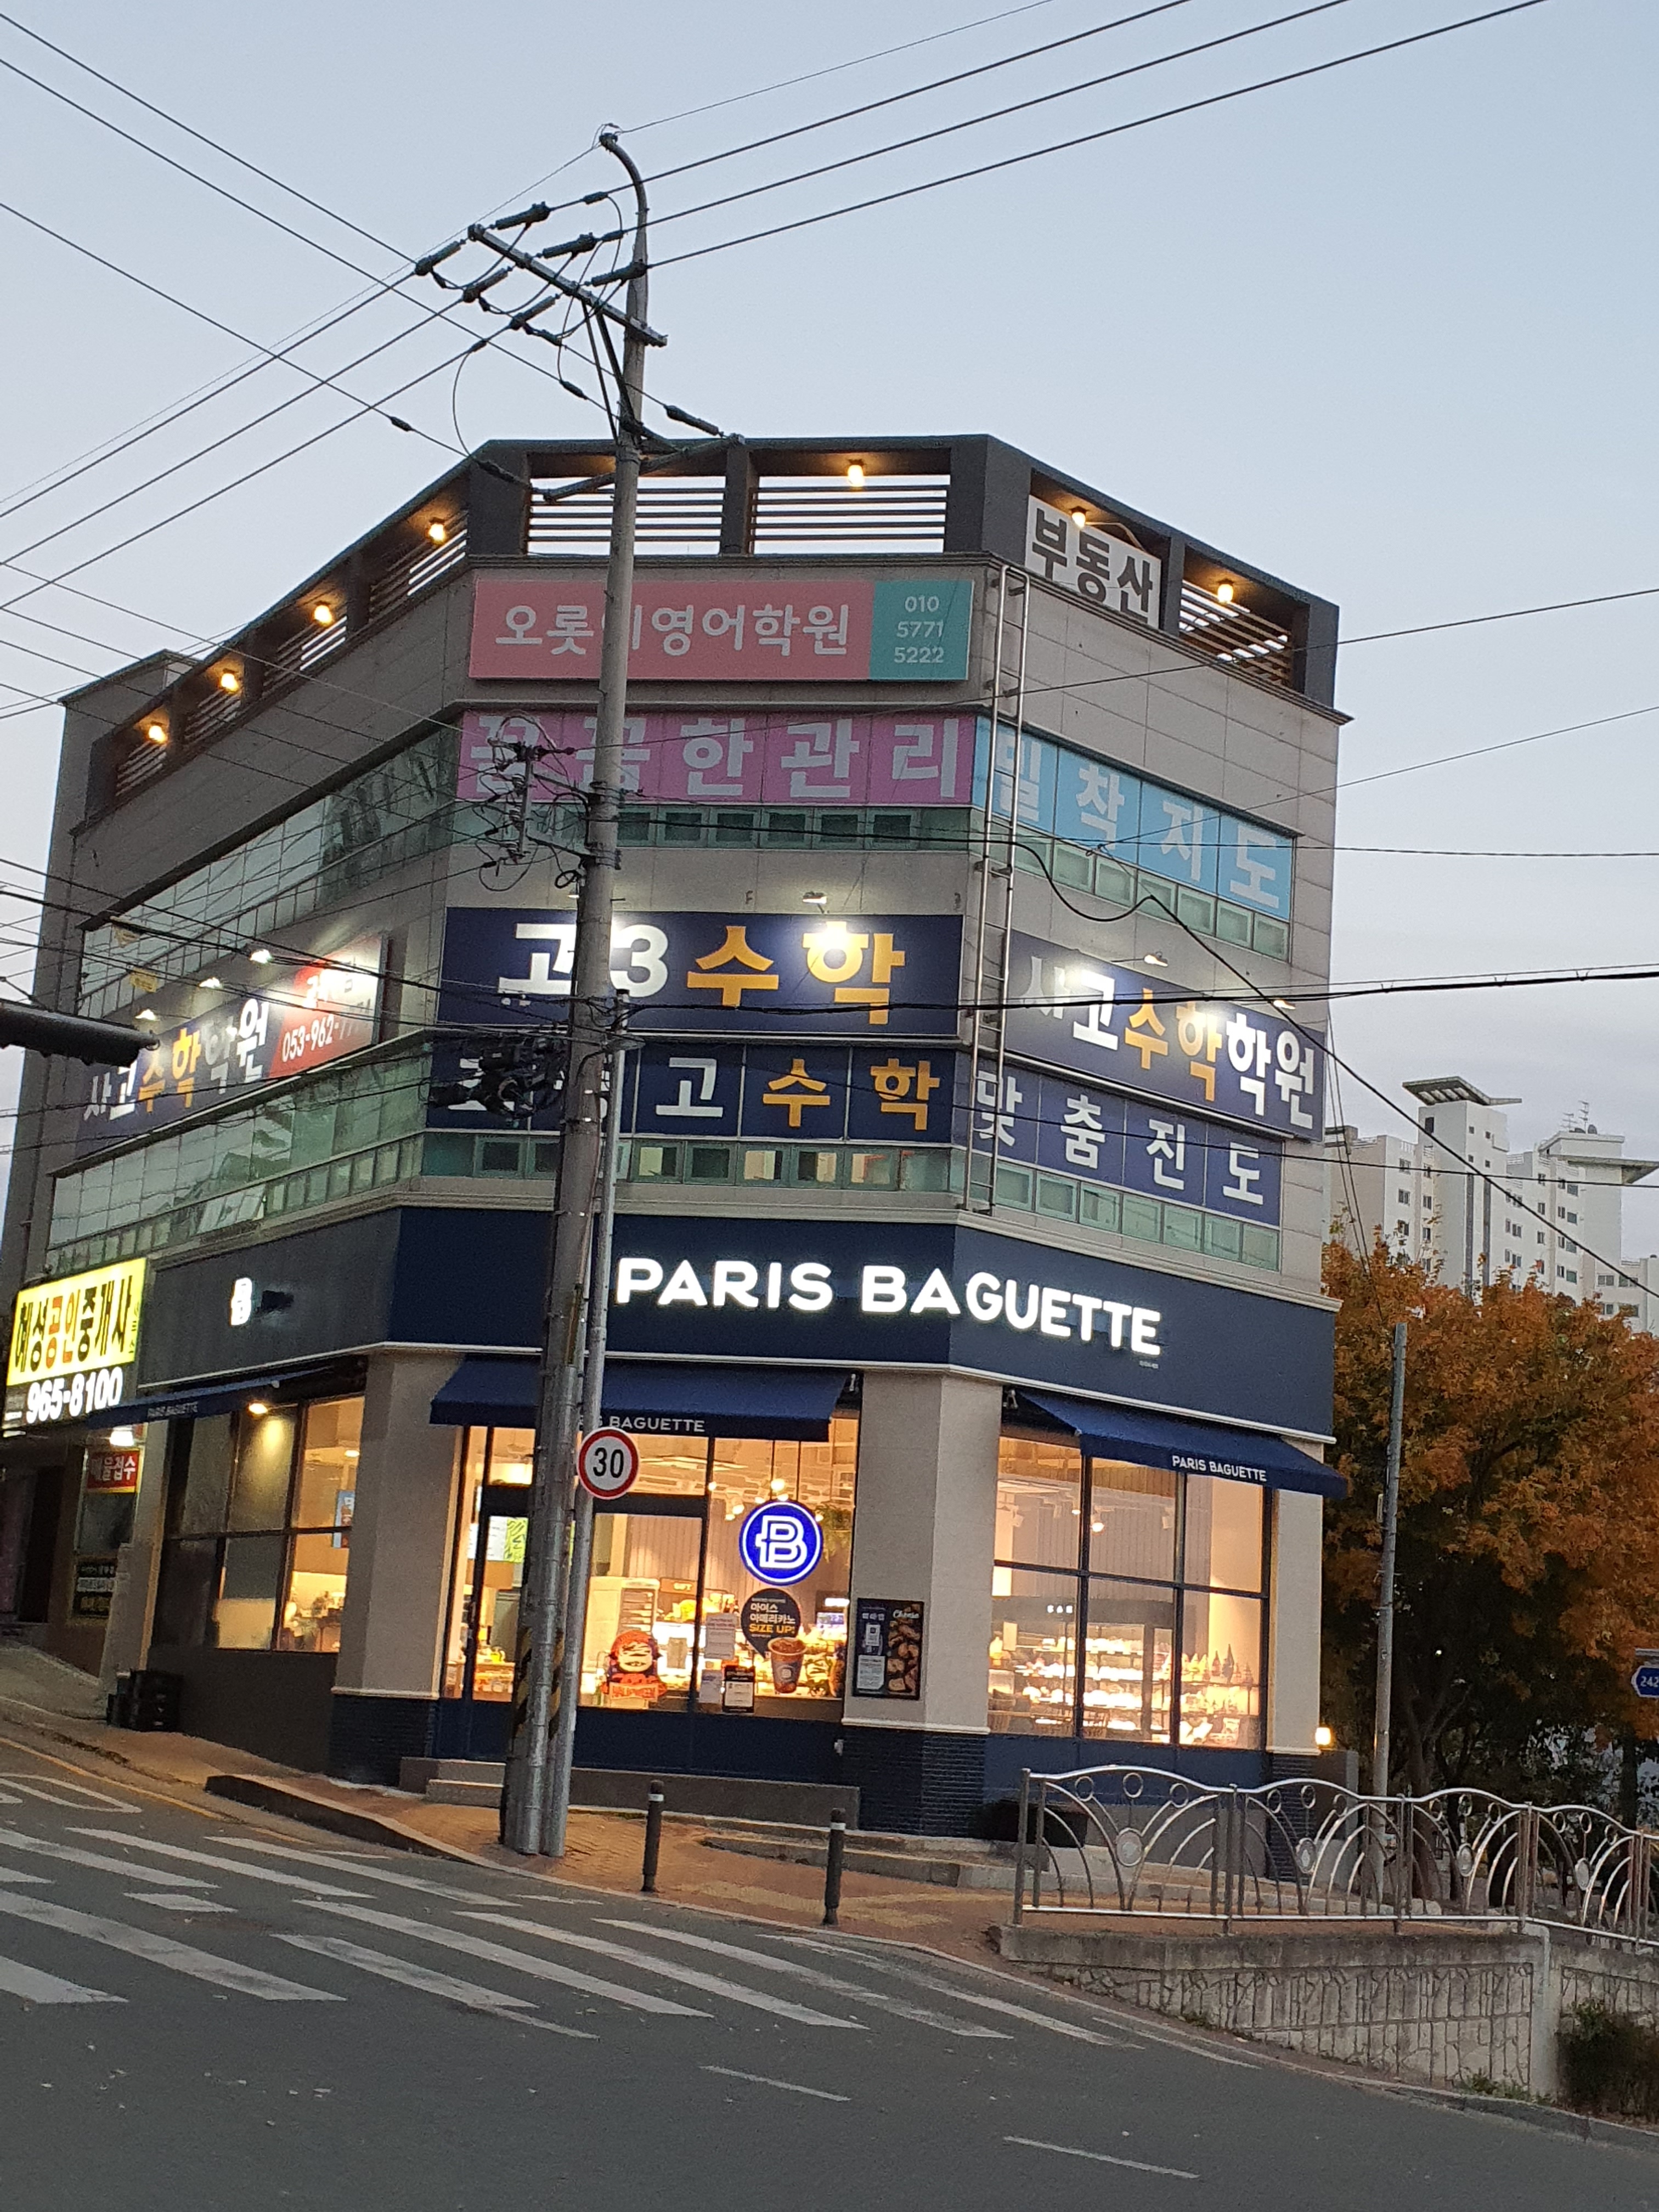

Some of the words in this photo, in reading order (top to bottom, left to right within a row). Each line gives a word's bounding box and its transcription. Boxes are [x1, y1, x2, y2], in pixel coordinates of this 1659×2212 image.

[1032, 508, 1154, 623] 부동산
[905, 595, 939, 612] 010
[896, 619, 944, 637] 5771
[894, 646, 944, 663] 5222
[616, 1257, 833, 1312] PARIS
[861, 1265, 1162, 1356] BAGUETTE
[26, 1366, 123, 1424] 965-8100
[609, 1415, 706, 1432] BAGUETTE
[592, 1447, 624, 1479] 30
[1172, 1455, 1206, 1471] PARIS
[1209, 1461, 1267, 1482] BAGUETTE
[749, 1624, 774, 1633] SIZE
